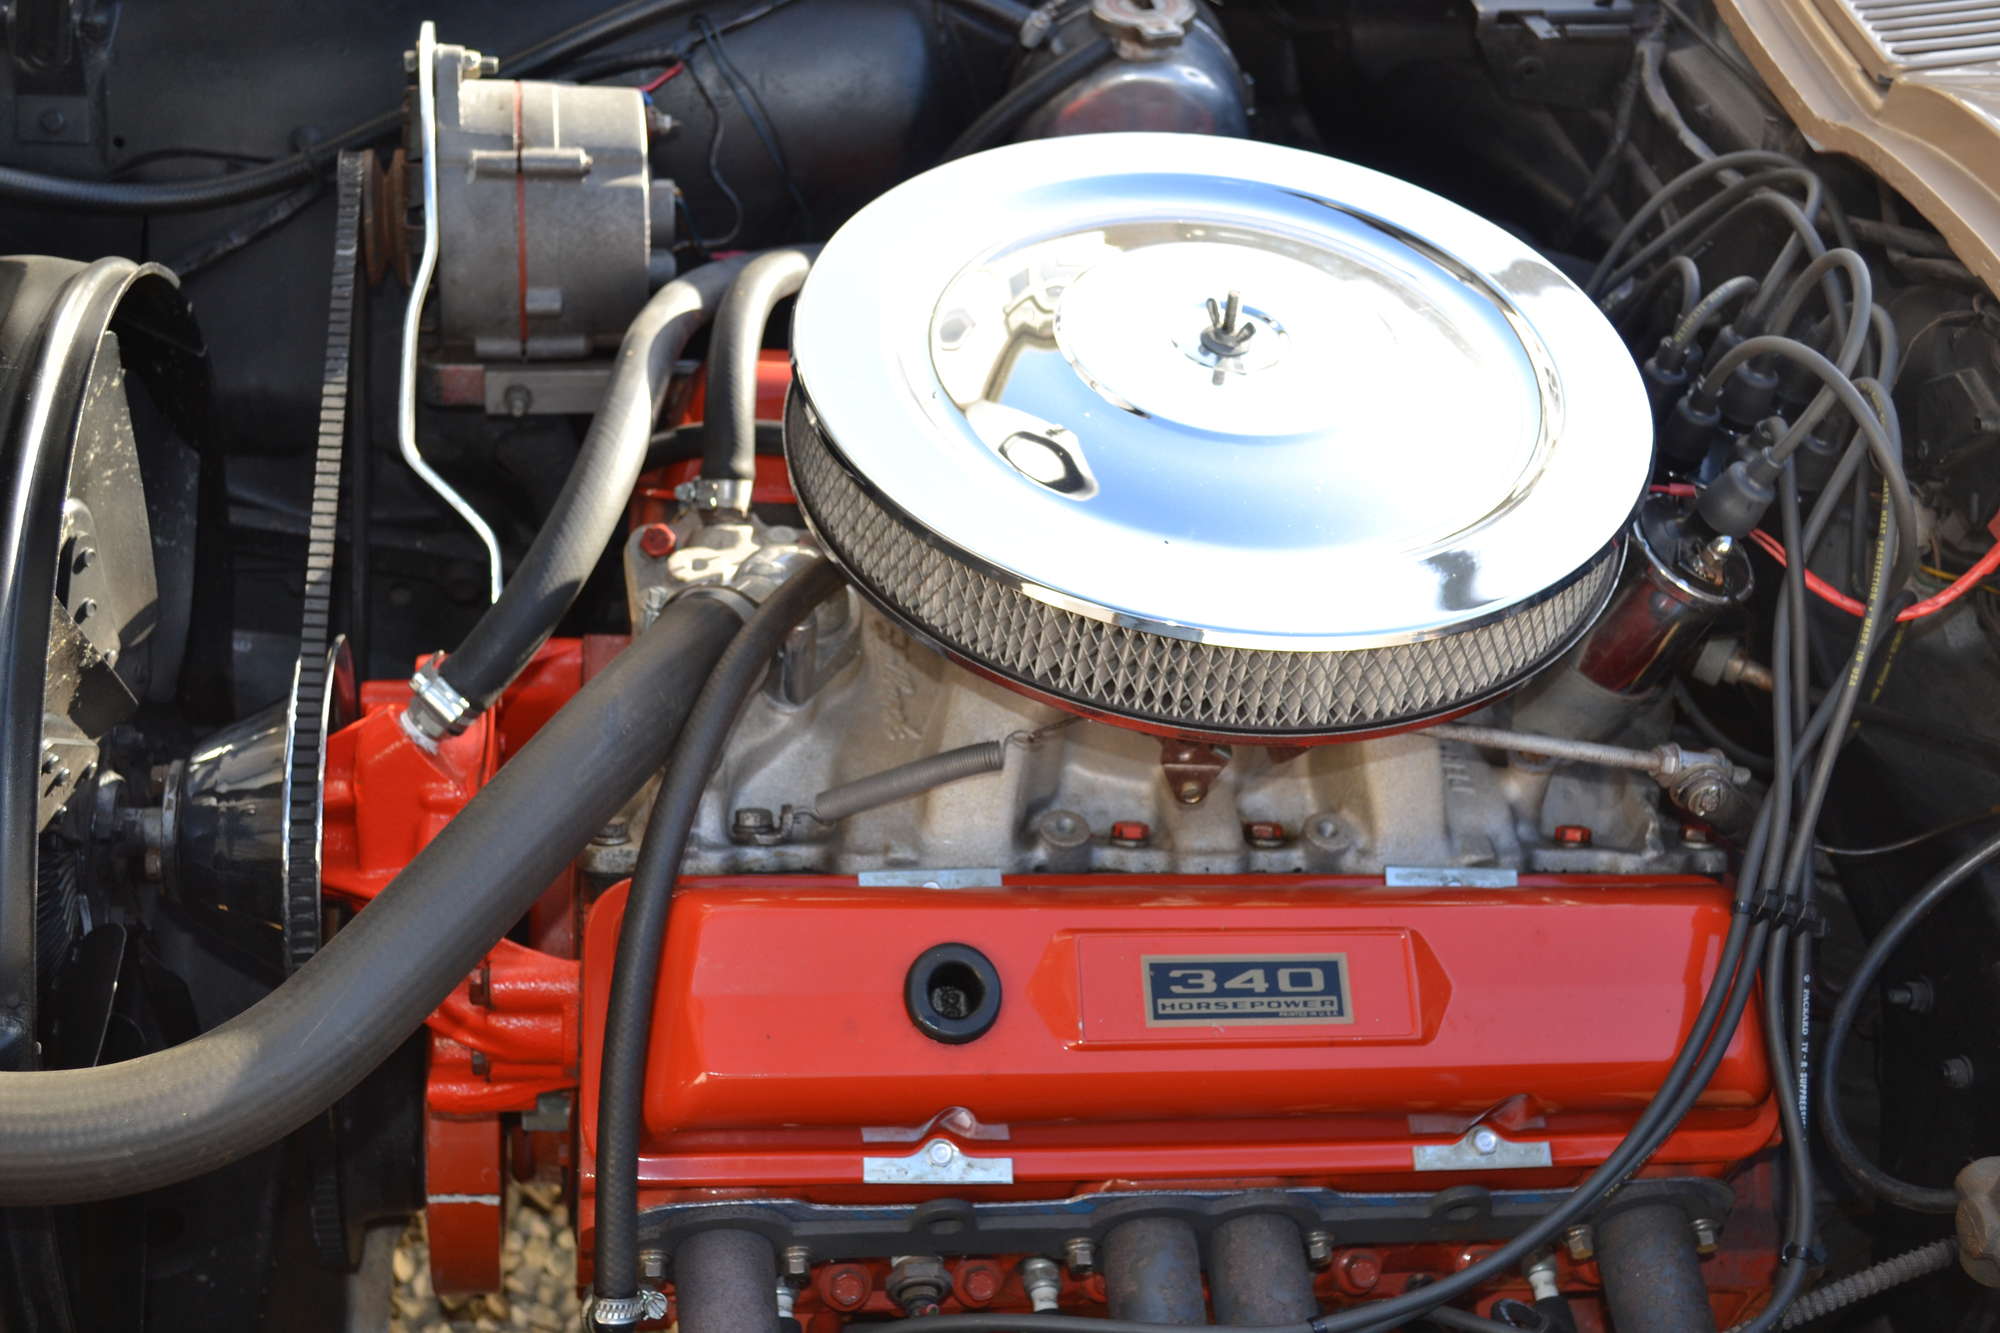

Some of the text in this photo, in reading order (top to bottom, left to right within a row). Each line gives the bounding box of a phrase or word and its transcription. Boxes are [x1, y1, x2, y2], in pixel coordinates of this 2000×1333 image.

[1879, 510, 1888, 535] HEAT
[1869, 540, 1885, 600] PROTECTION
[1855, 650, 1865, 663] IN
[1168, 967, 1325, 994] 340
[1160, 1000, 1336, 1012] HORSEPOWER
